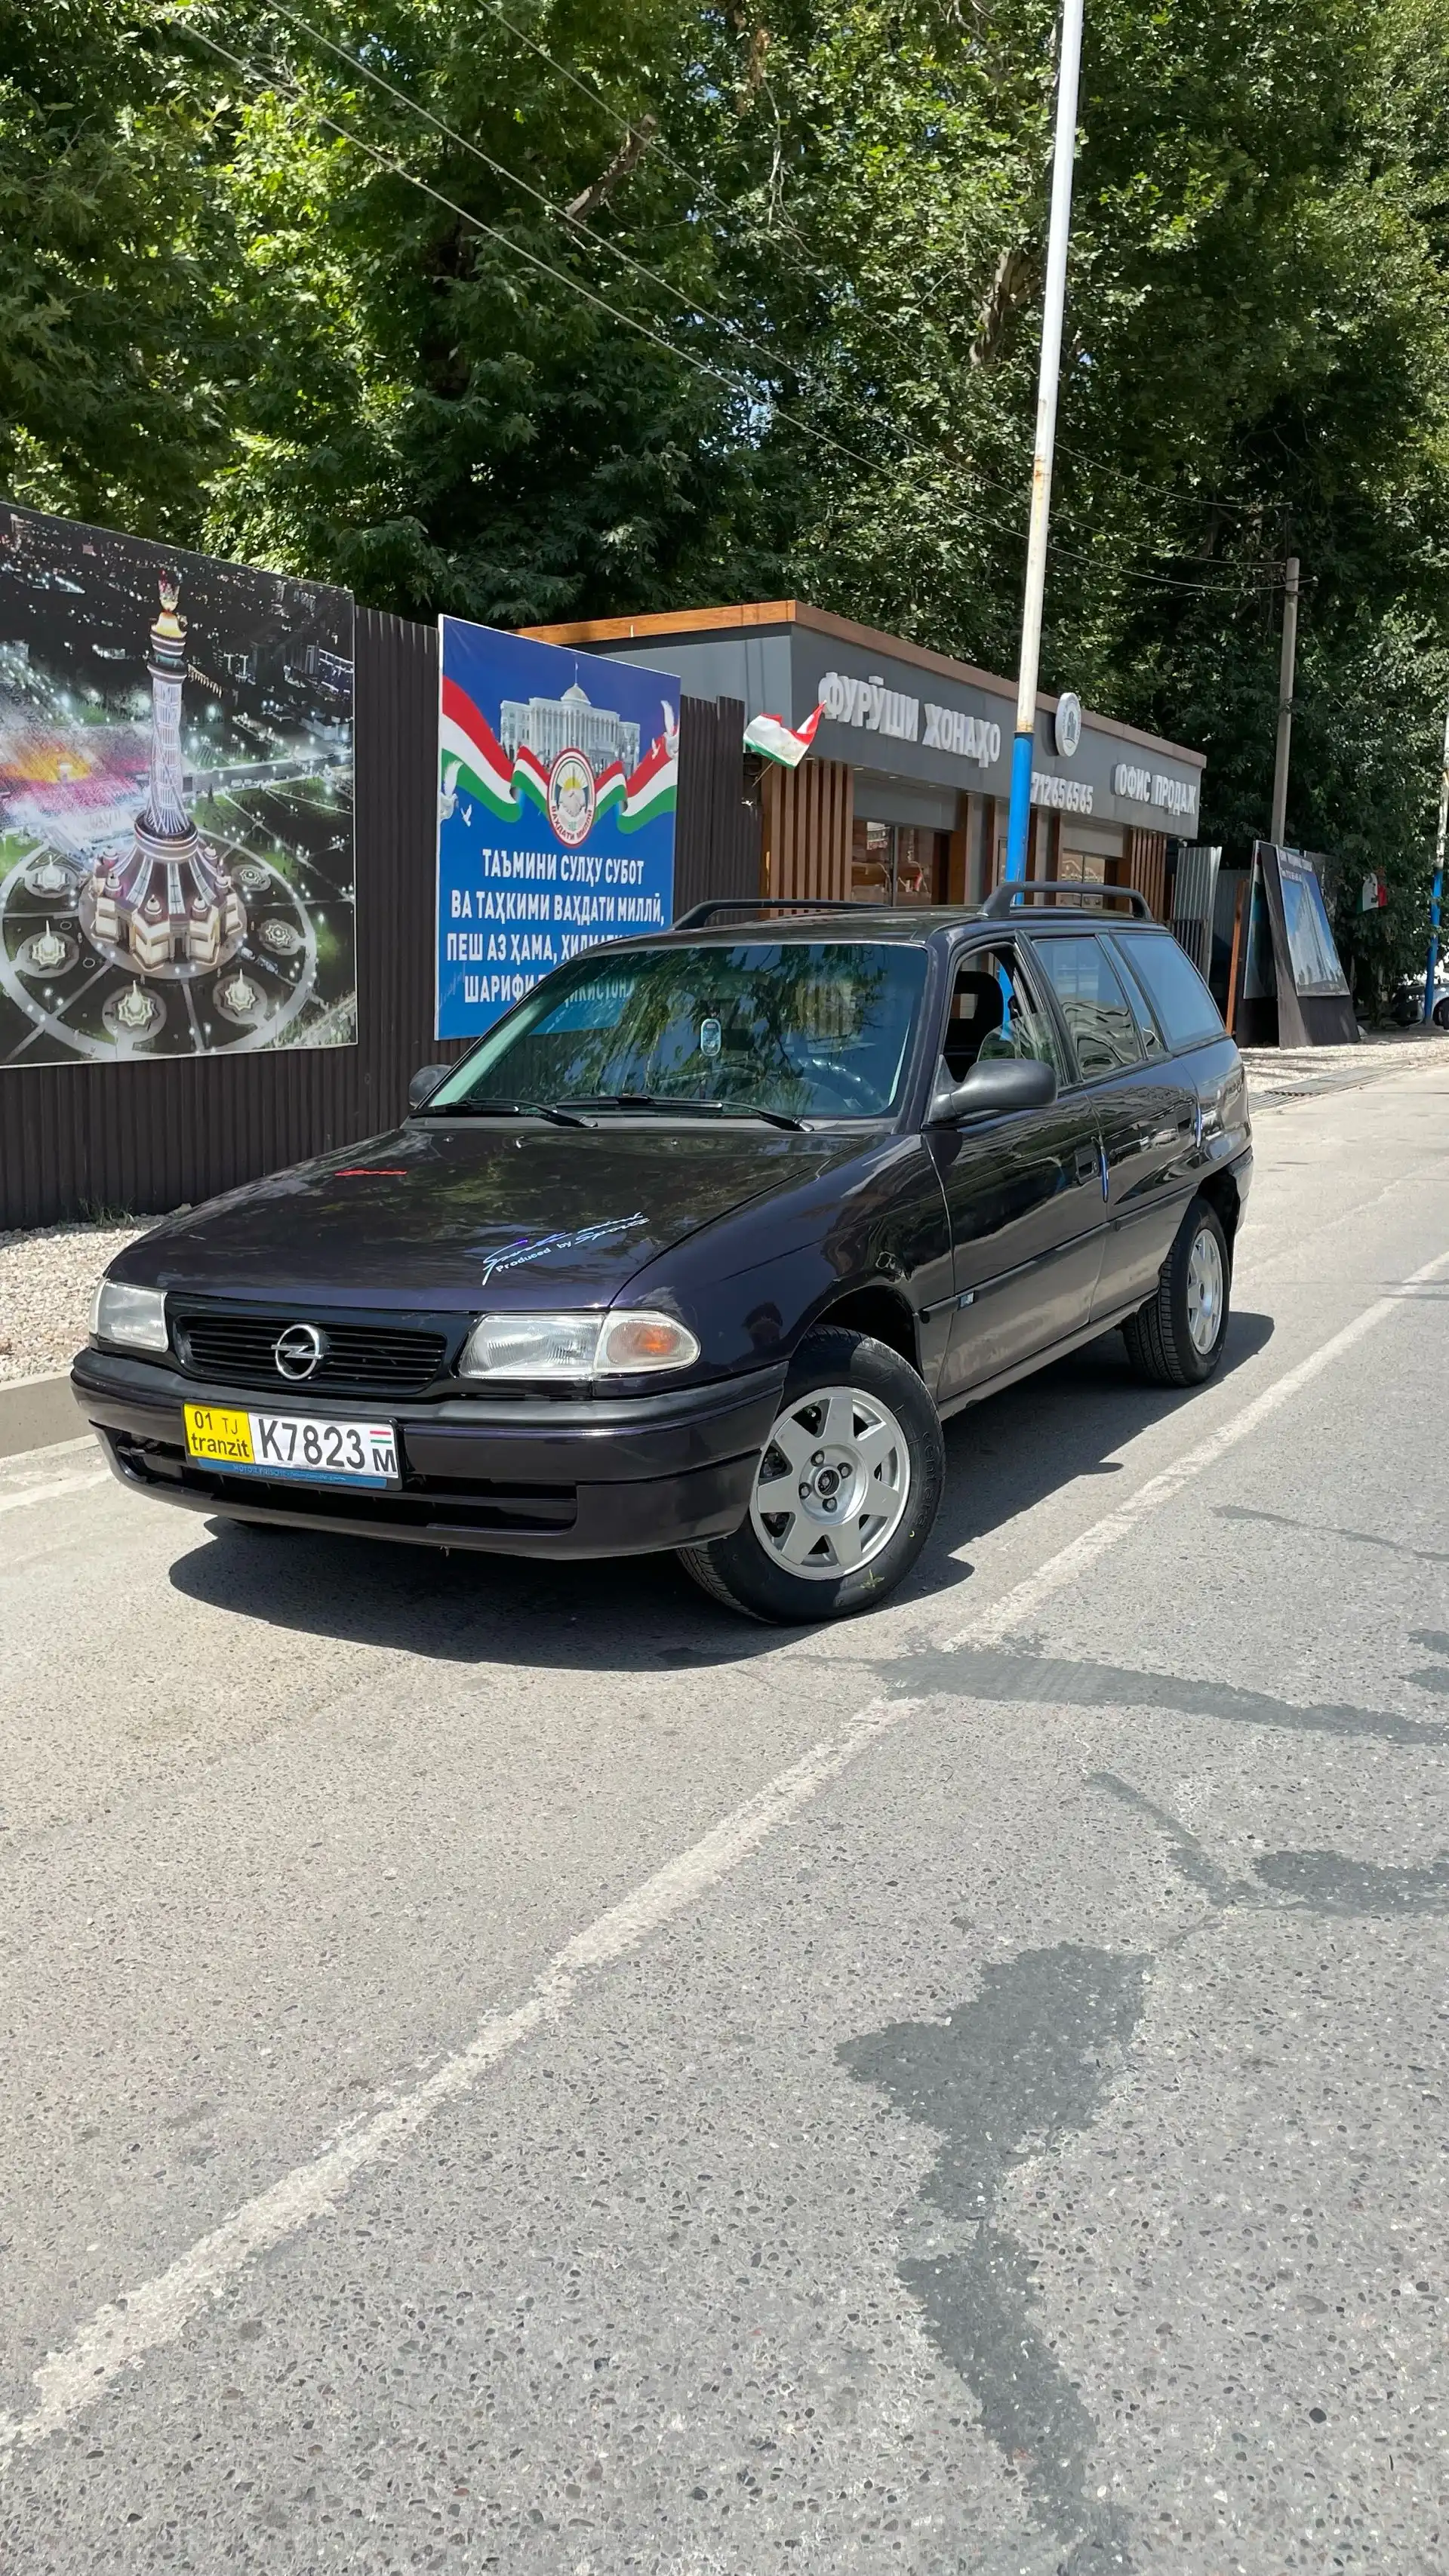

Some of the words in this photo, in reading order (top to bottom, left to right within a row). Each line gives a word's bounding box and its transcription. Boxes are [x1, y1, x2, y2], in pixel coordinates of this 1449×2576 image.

[818, 672, 919, 742] ФУРӮШИ
[1115, 764, 1151, 802] ОФИС
[1150, 774, 1197, 816] ПРОДАЖ
[482, 848, 557, 881] ТАЪМИНИ
[561, 855, 603, 887] СУЛҲУ
[605, 858, 645, 885] СУБОТ
[451, 890, 472, 919] ВА
[476, 891, 550, 925] ТАҲКИМИ
[554, 894, 614, 926] ВАҲДАТИ
[447, 933, 483, 962] ПЕШ
[487, 933, 506, 962] АЗ
[510, 934, 557, 966] ҲАМА,
[496, 1247, 552, 1273] Produced
[556, 1240, 573, 1251] by
[194, 1410, 213, 1430] 01
[221, 1417, 238, 1434] TJ
[191, 1433, 250, 1457] tranzit
[258, 1417, 365, 1470] K7823
[372, 1448, 397, 1472] M
